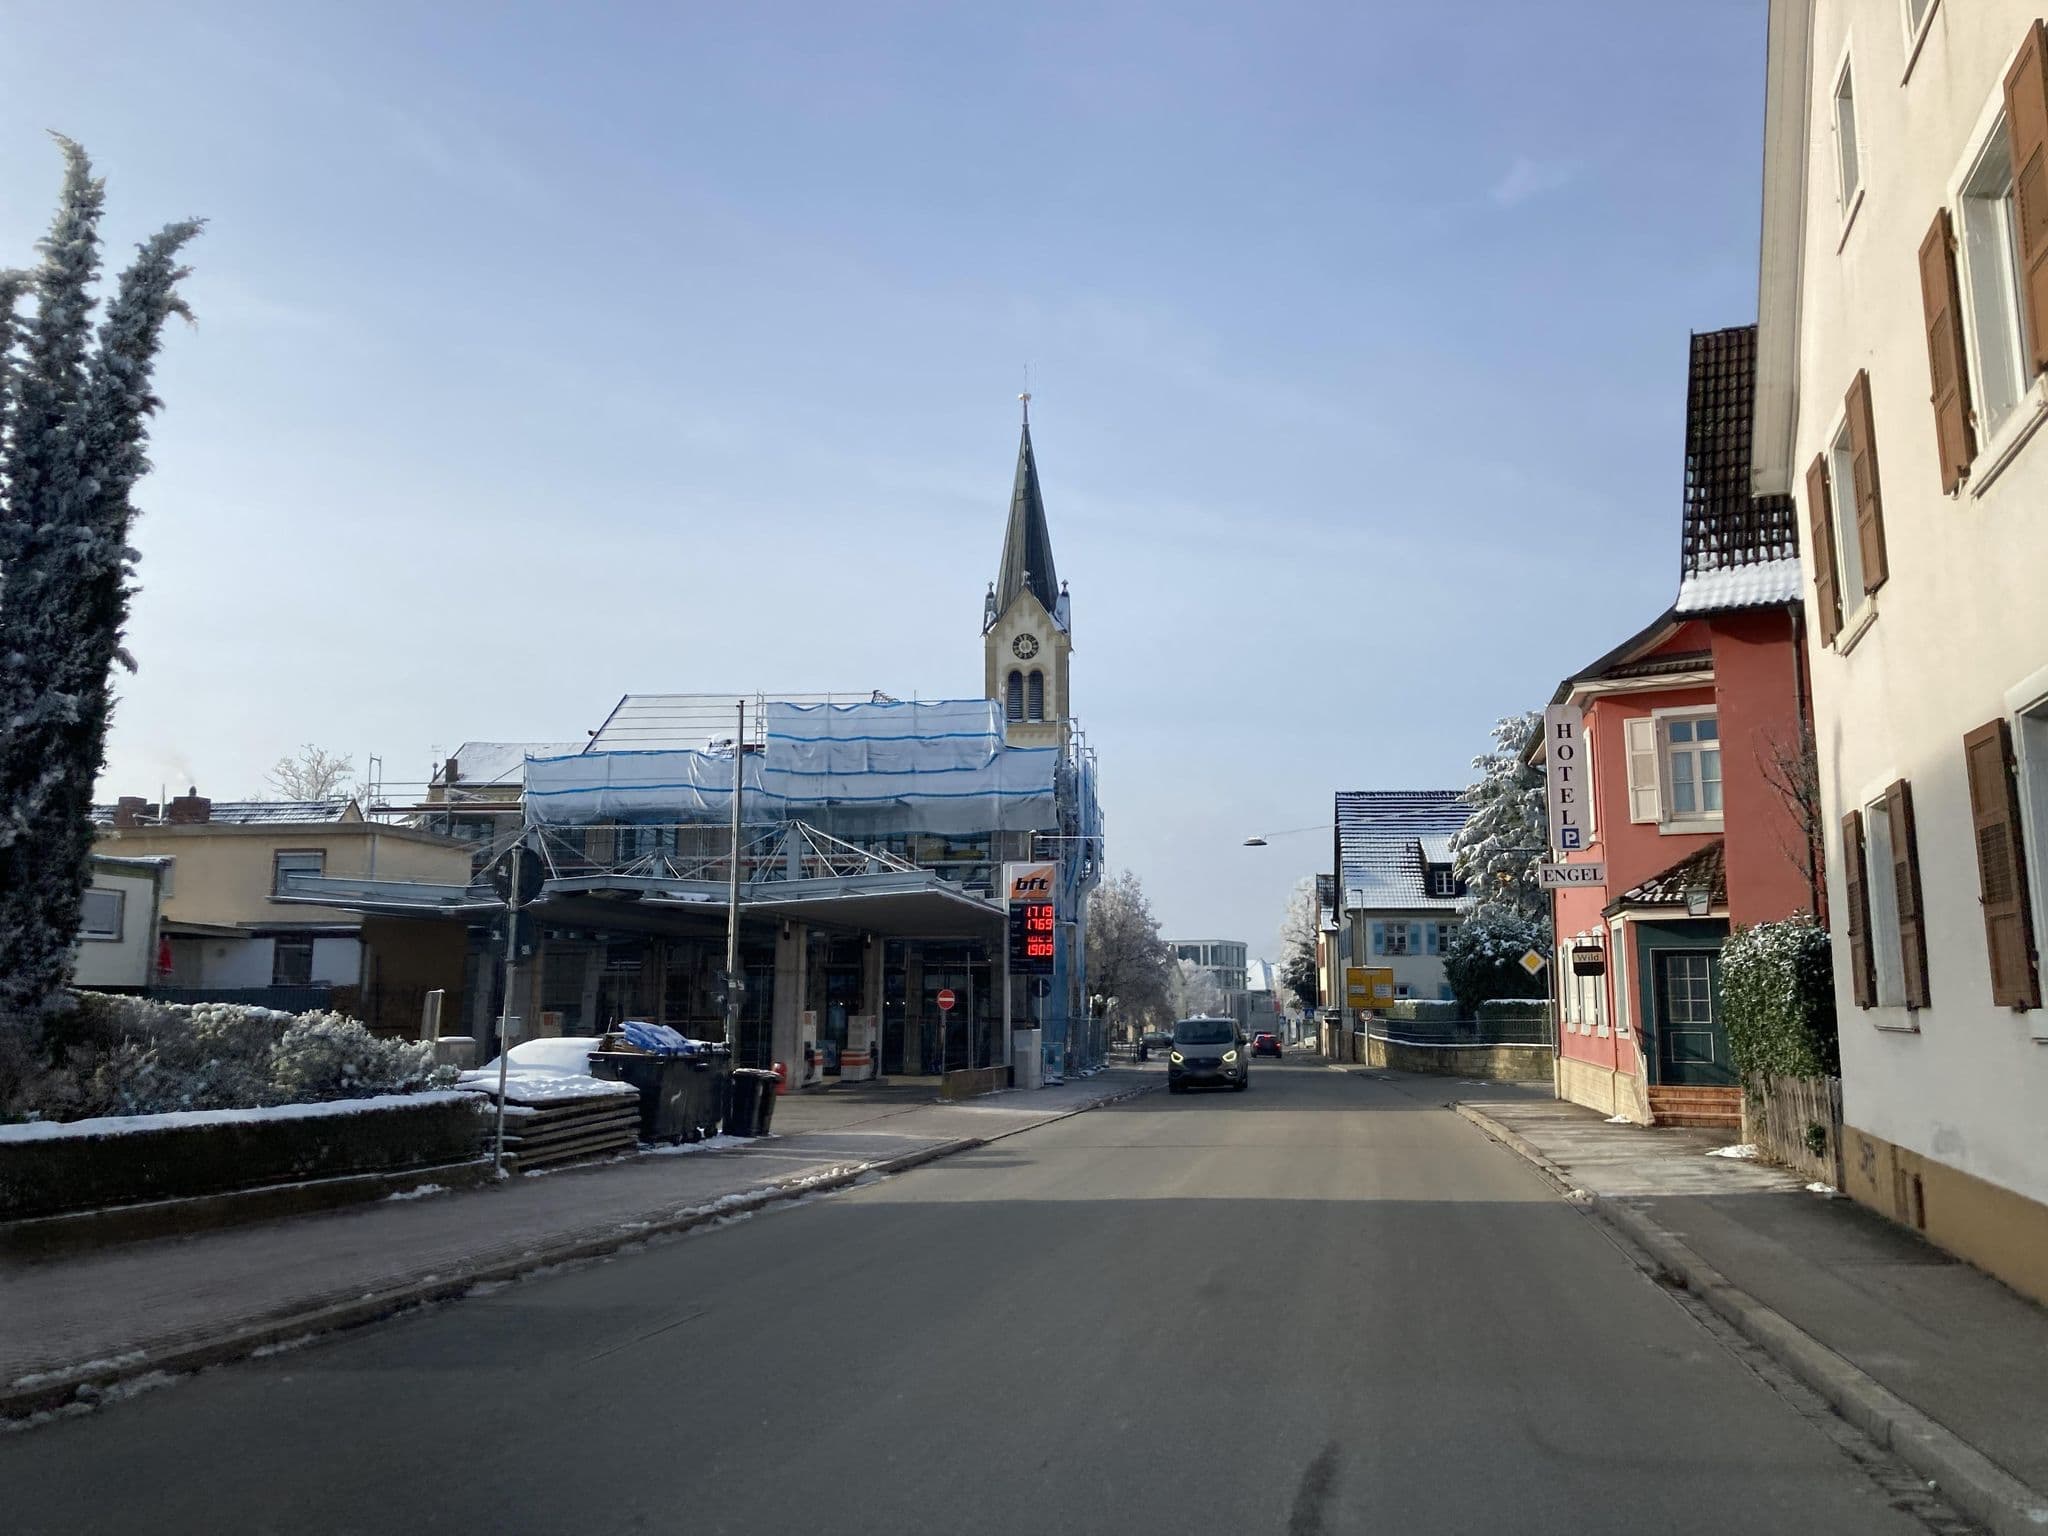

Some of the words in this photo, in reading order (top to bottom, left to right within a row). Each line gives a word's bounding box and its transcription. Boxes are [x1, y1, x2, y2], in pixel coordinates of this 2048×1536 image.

[1556, 723, 1575, 826] HOTEL
[1543, 868, 1604, 883] ENGEL
[1015, 877, 1048, 891] bft
[1577, 953, 1599, 962] Wild
